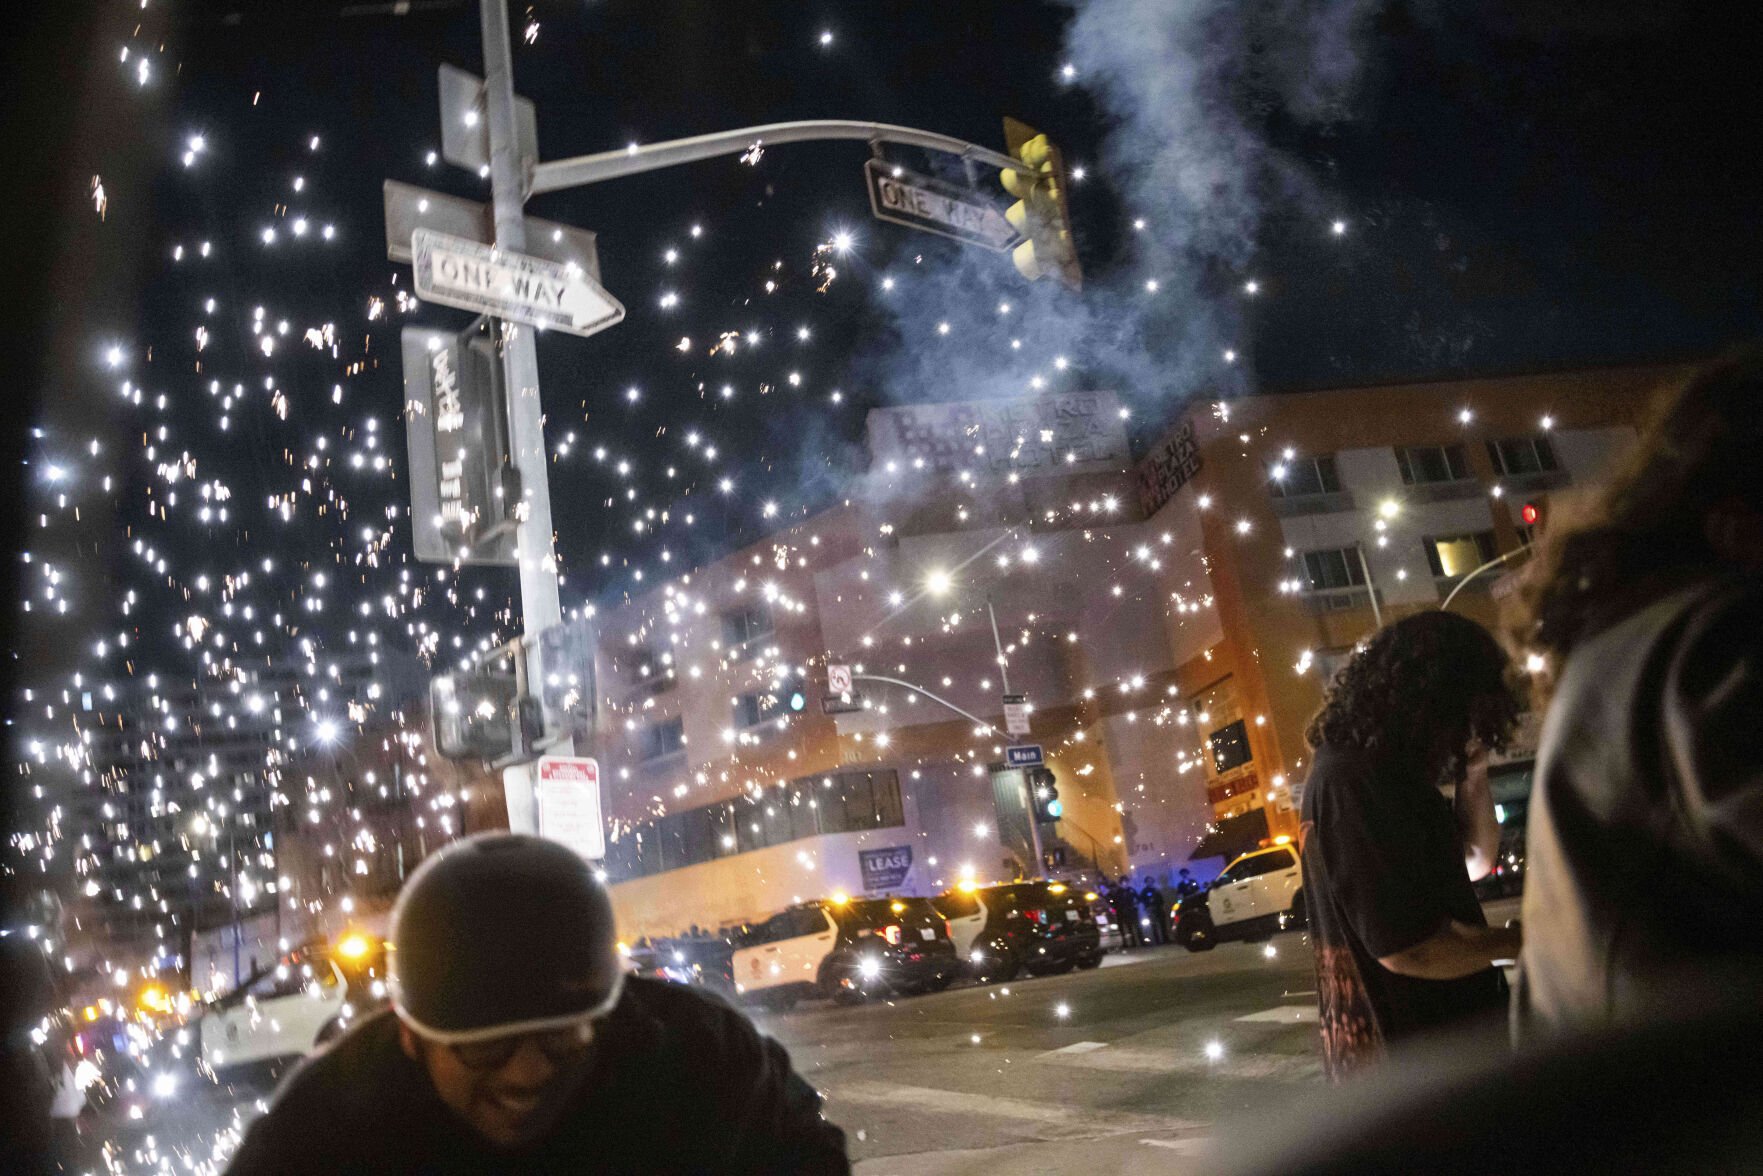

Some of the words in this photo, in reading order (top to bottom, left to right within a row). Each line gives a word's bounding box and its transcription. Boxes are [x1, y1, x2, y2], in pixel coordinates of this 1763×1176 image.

[884, 182, 931, 217] ONE
[511, 275, 566, 307] WAY
[1013, 751, 1037, 762] Main
[868, 855, 909, 872] LEASE
